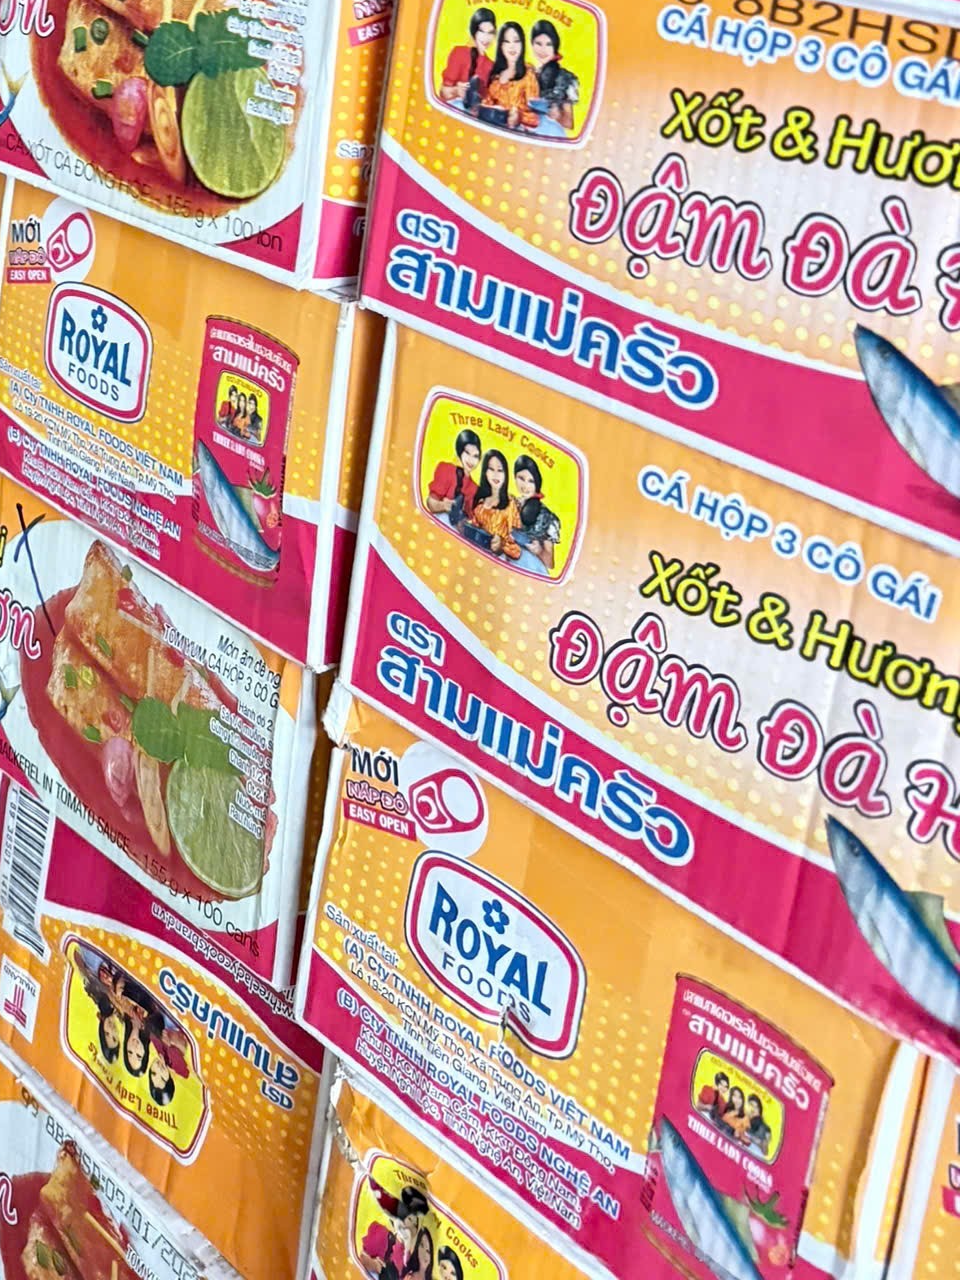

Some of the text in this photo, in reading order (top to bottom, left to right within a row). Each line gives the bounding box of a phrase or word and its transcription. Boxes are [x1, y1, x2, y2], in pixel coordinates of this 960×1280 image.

[535, 0, 574, 29] Cooks
[661, 2, 888, 82] CÁ HỘP 3 CÔ
[661, 88, 818, 163] Xốt &
[11, 220, 41, 244] MỚI
[570, 153, 922, 316] Đậm Đà
[10, 268, 48, 282] EASY OPEN
[59, 307, 132, 388] ROYAL
[387, 246, 717, 409] สามแม่ครัว
[68, 362, 121, 402] FOODS
[212, 344, 286, 393] สามแม่ครัว
[450, 412, 555, 469] Three Lady Cooks
[640, 470, 939, 621] CÁ HỘP 3 CÔ GÁI
[640, 551, 793, 649] Xốt &
[378, 644, 695, 866] สามแม่ครัว
[549, 612, 891, 820] Đậm Đà
[352, 747, 399, 787] MỚI
[349, 804, 409, 835] EASY OPEN
[42, 778, 54, 793] IN
[55, 784, 95, 826] TOMATO
[96, 817, 130, 852] SAUCE
[142, 854, 166, 886] 155
[168, 881, 180, 897] g
[197, 896, 223, 926] 100
[225, 923, 260, 957] cans
[429, 881, 552, 1017] ROYAL
[158, 968, 300, 1090] สามแม่ครัว
[344, 938, 630, 1161] (A) Cty TNHH ROYAL FOODS VIỆT NAM
[688, 1014, 810, 1111] สามแม่ครัว
[260, 1081, 293, 1111] ตรา
[687, 1114, 716, 1147] THREE
[716, 1136, 741, 1165] LADY
